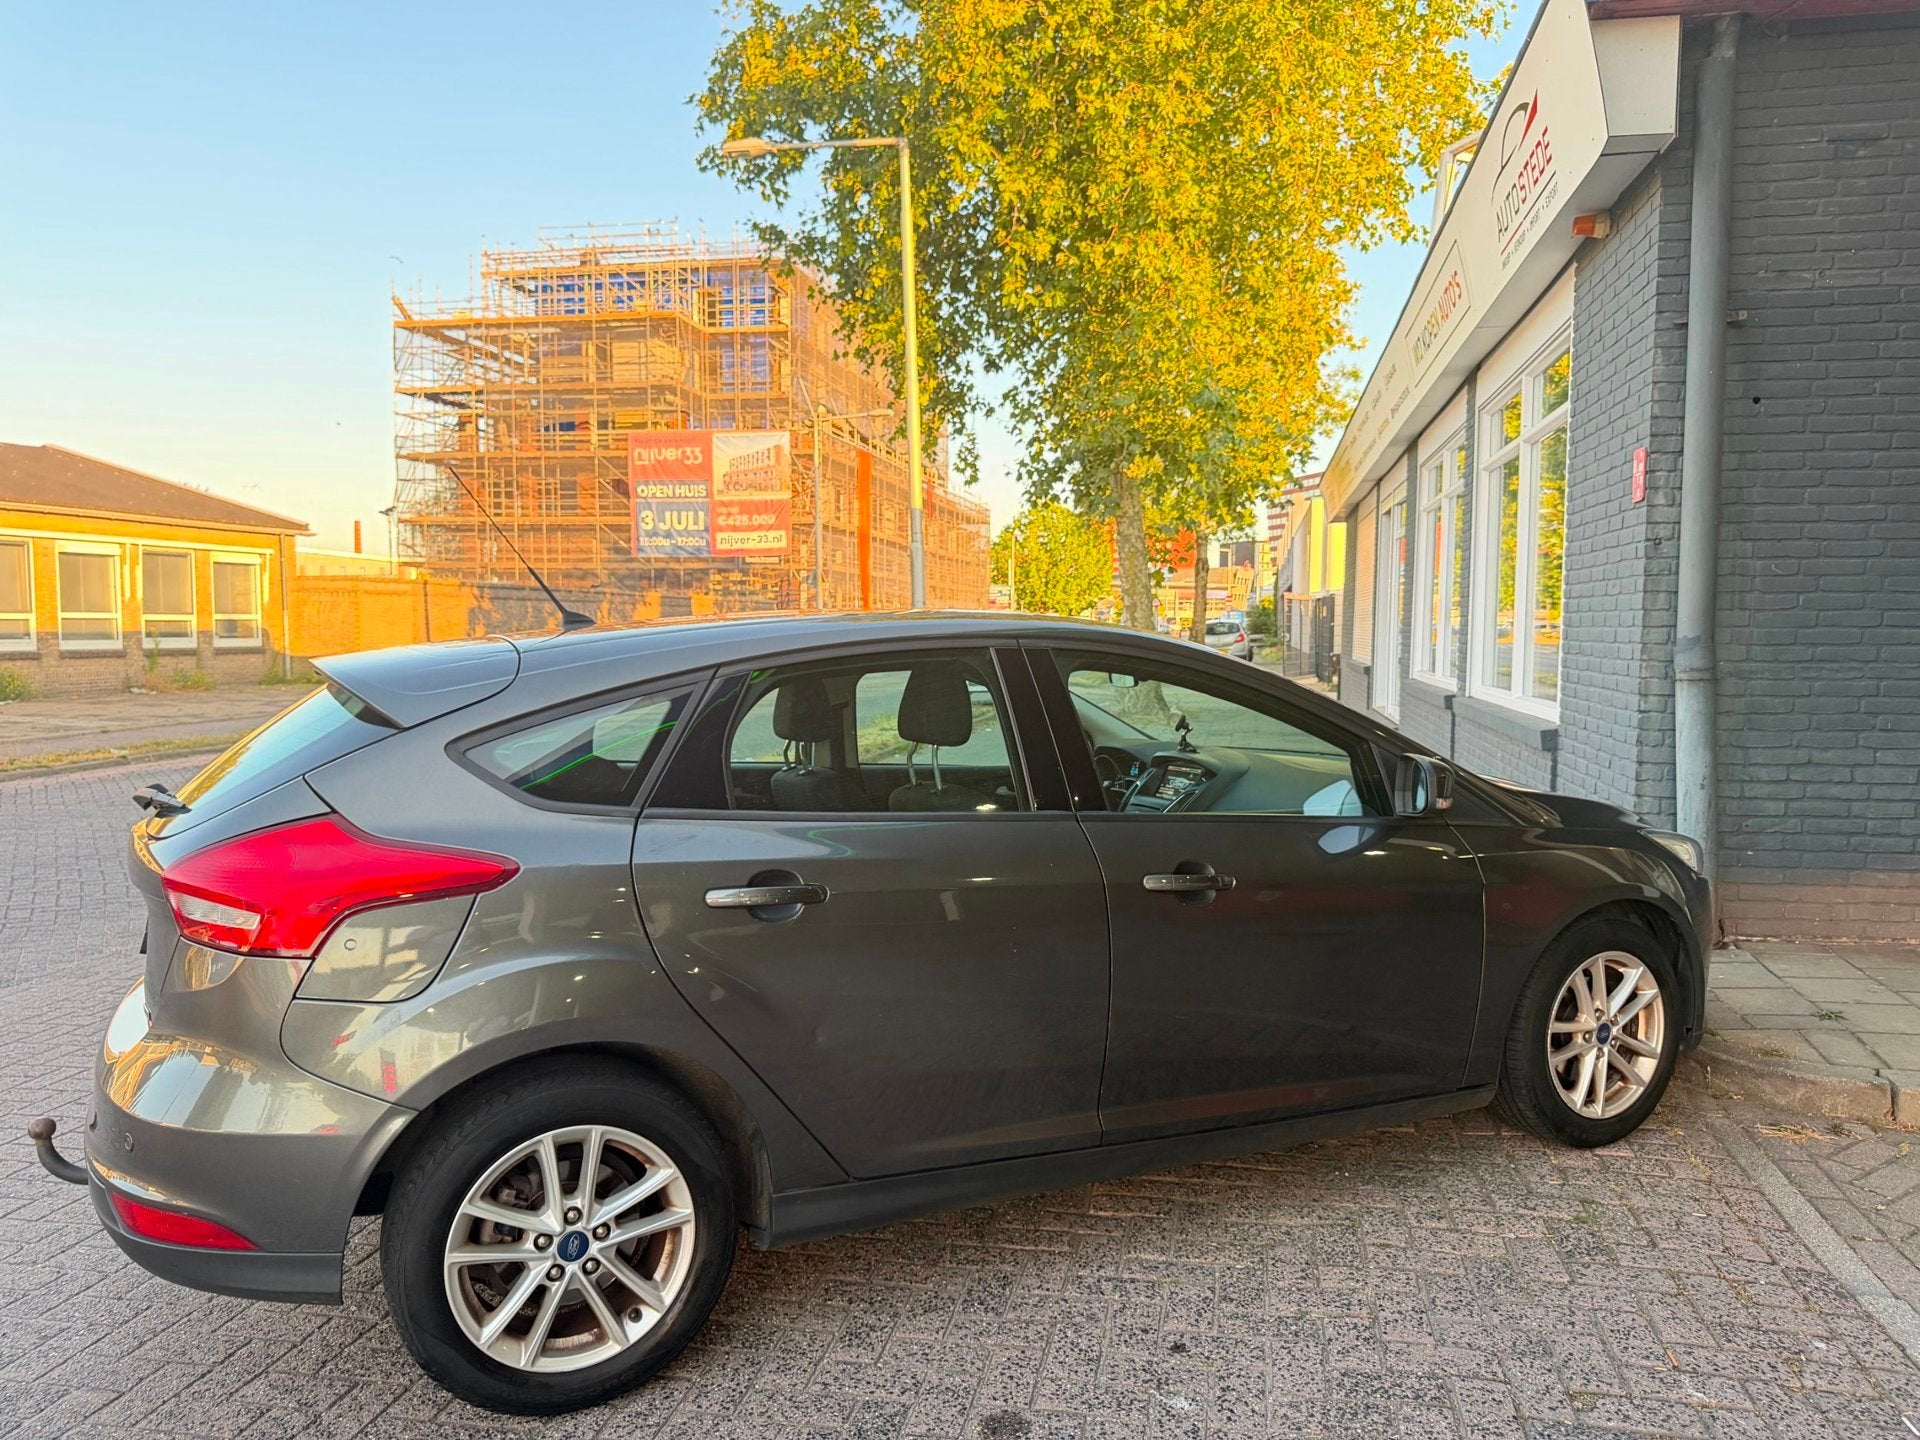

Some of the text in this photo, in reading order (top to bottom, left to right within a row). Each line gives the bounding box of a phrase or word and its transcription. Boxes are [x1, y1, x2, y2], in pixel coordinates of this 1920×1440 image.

[1438, 269, 1462, 328] AUTO'S
[636, 484, 707, 498] OPEN HUIS
[640, 510, 705, 531] 3 JULI
[720, 534, 783, 547] nijver-33.nl
